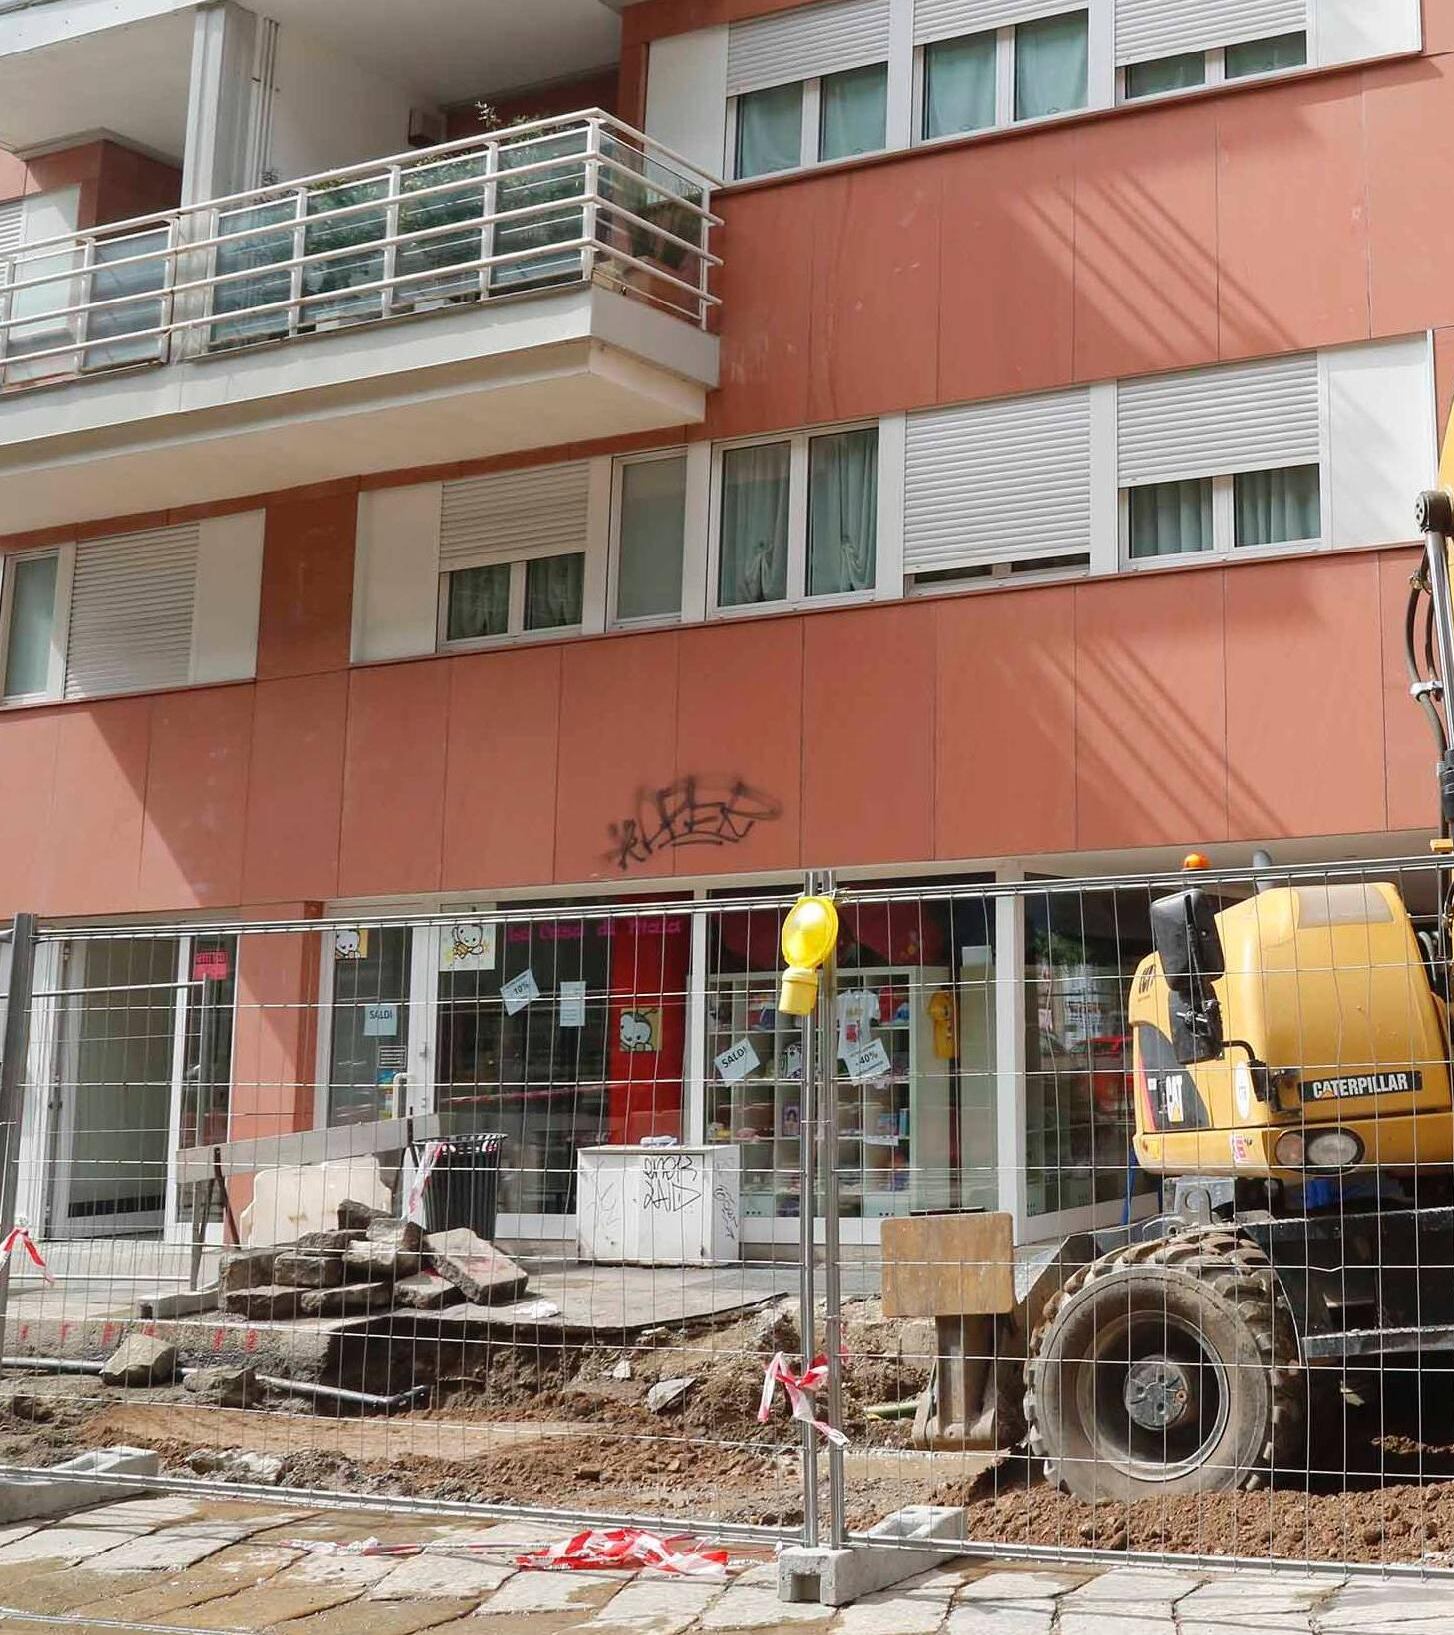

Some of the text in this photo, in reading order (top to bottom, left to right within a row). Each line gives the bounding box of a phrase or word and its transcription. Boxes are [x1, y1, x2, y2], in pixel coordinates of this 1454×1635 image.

[369, 1010, 393, 1020] SALDI
[1313, 1073, 1408, 1098] CATERPILLAR
[1166, 1075, 1183, 1122] CAT
